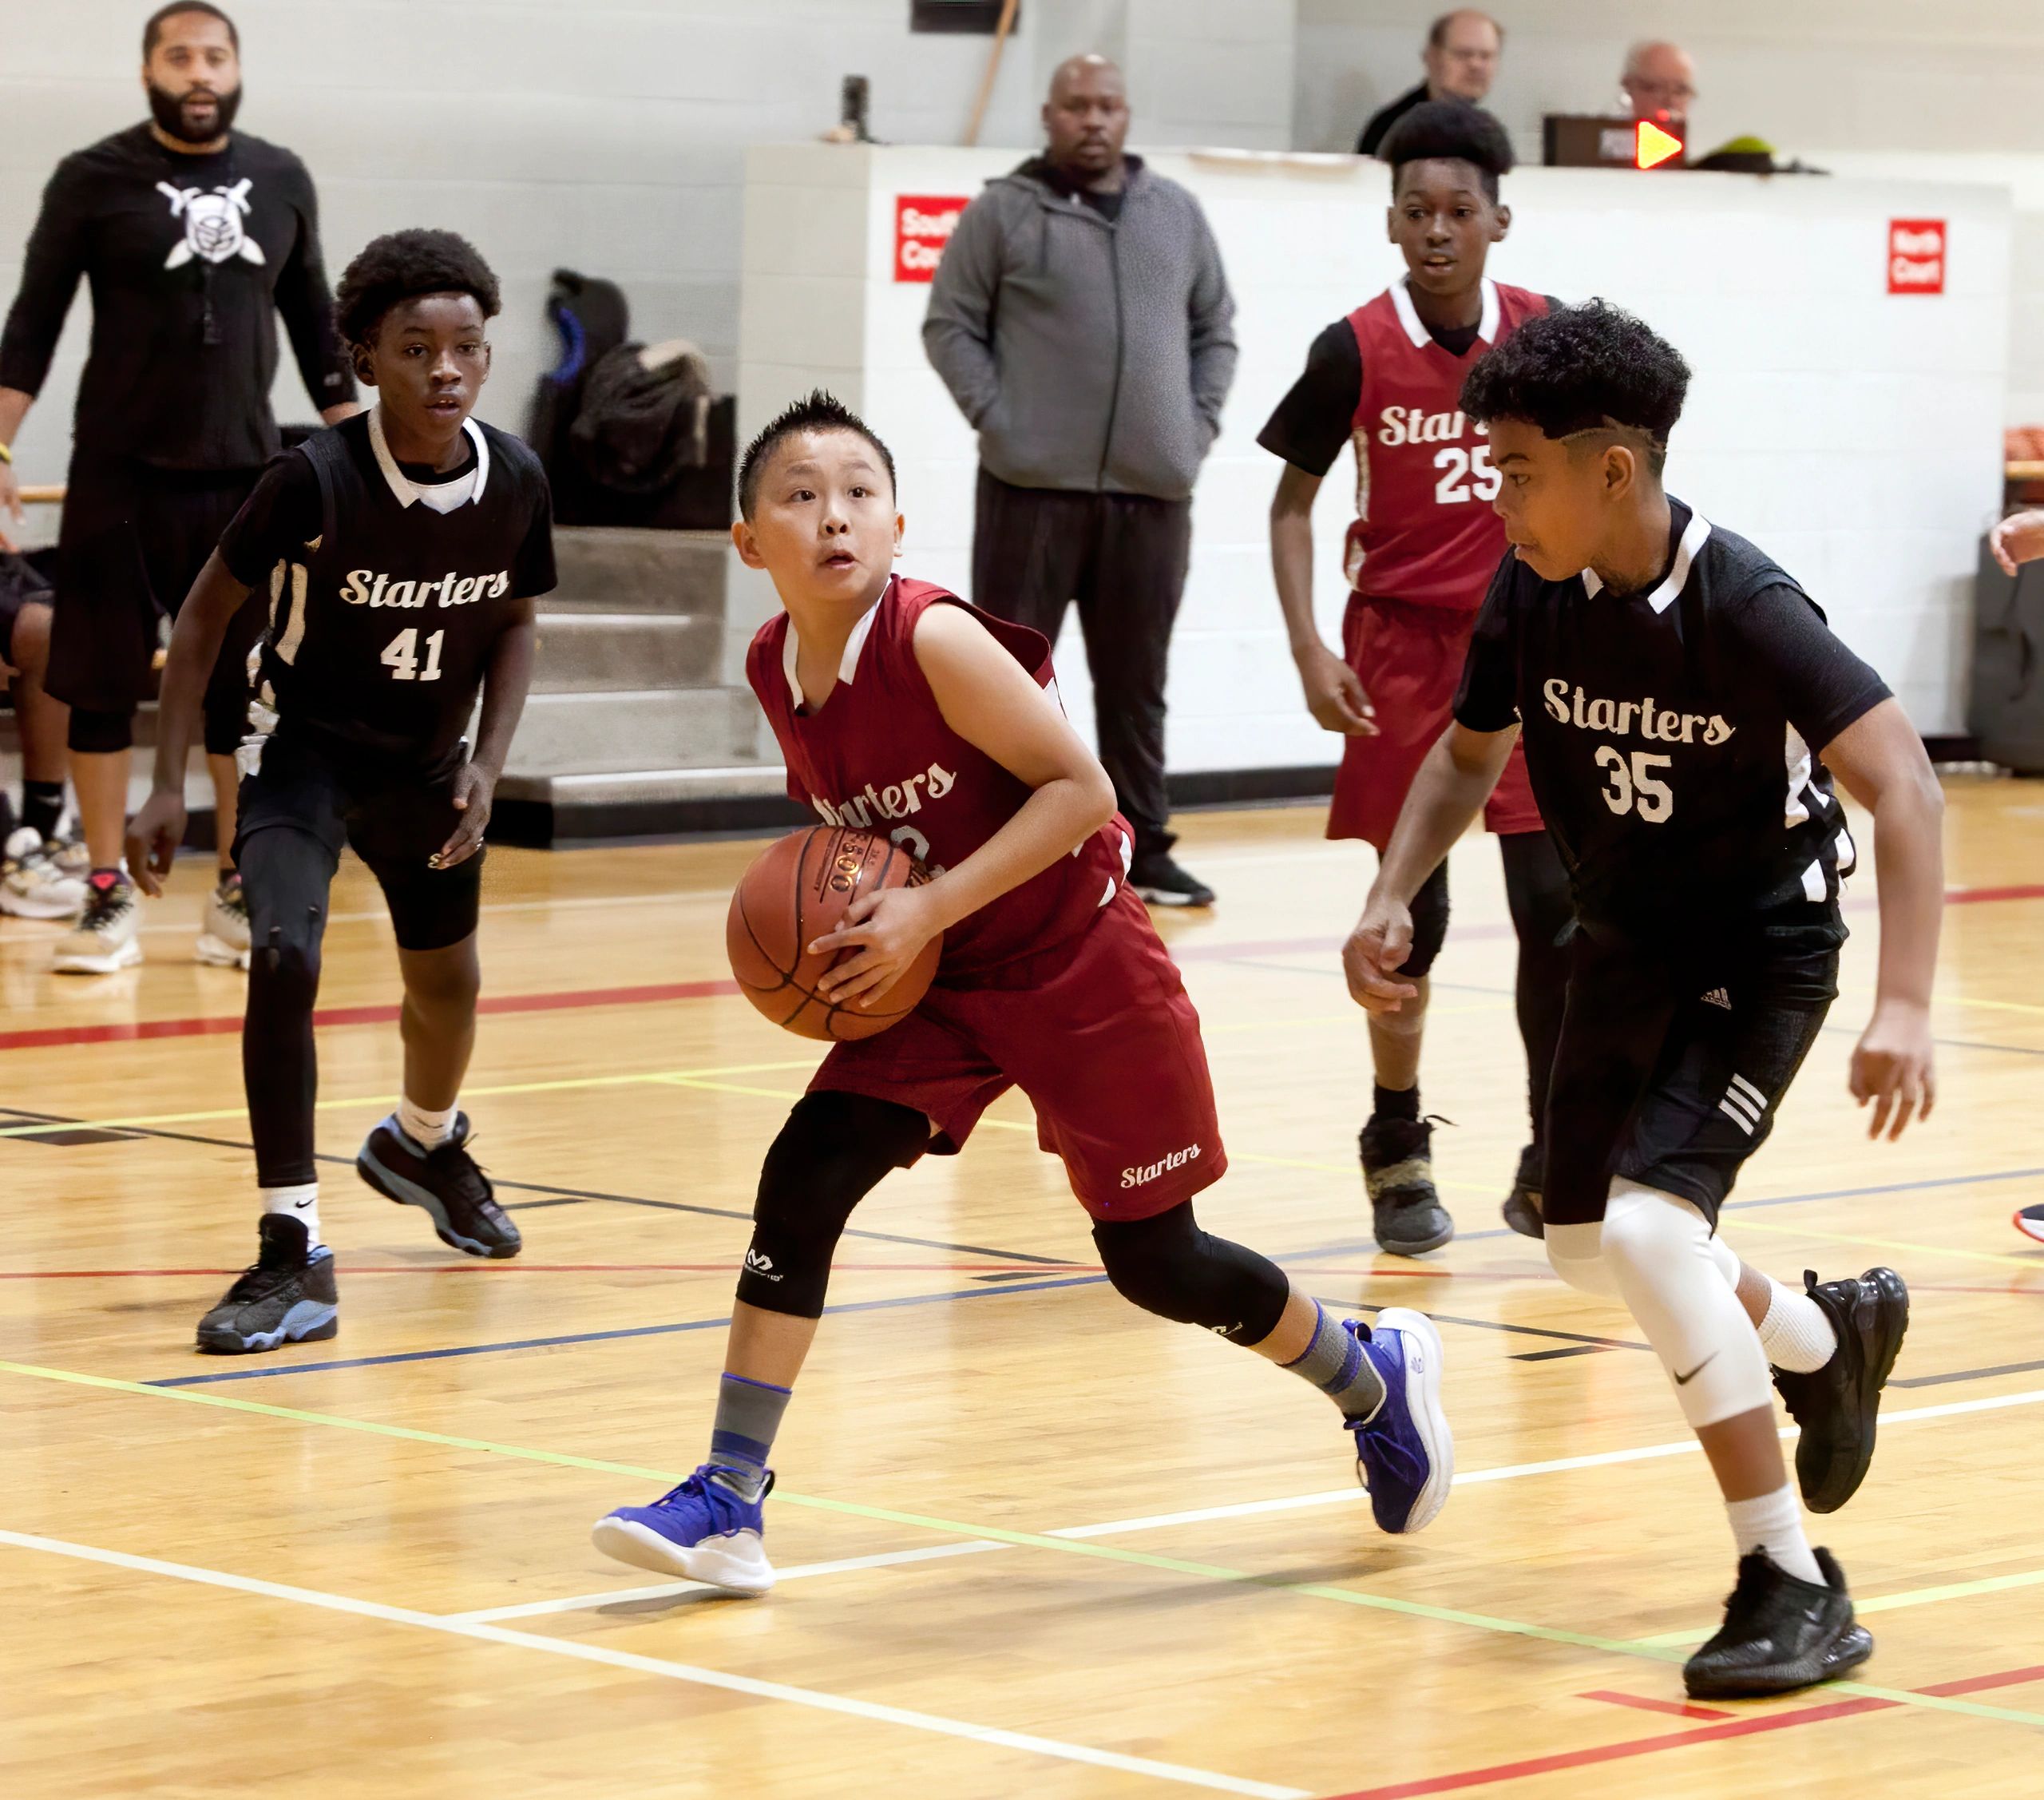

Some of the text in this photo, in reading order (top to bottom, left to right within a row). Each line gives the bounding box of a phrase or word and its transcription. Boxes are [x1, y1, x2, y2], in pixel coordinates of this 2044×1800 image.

[1378, 406, 1489, 446] Star
[1433, 445, 1503, 504] 25
[339, 569, 509, 609] Starters
[380, 628, 445, 681] 41
[1543, 679, 1737, 745] Starters
[811, 763, 957, 828] tarters
[1594, 746, 1674, 823] 35
[1120, 1143, 1202, 1188] Starters
